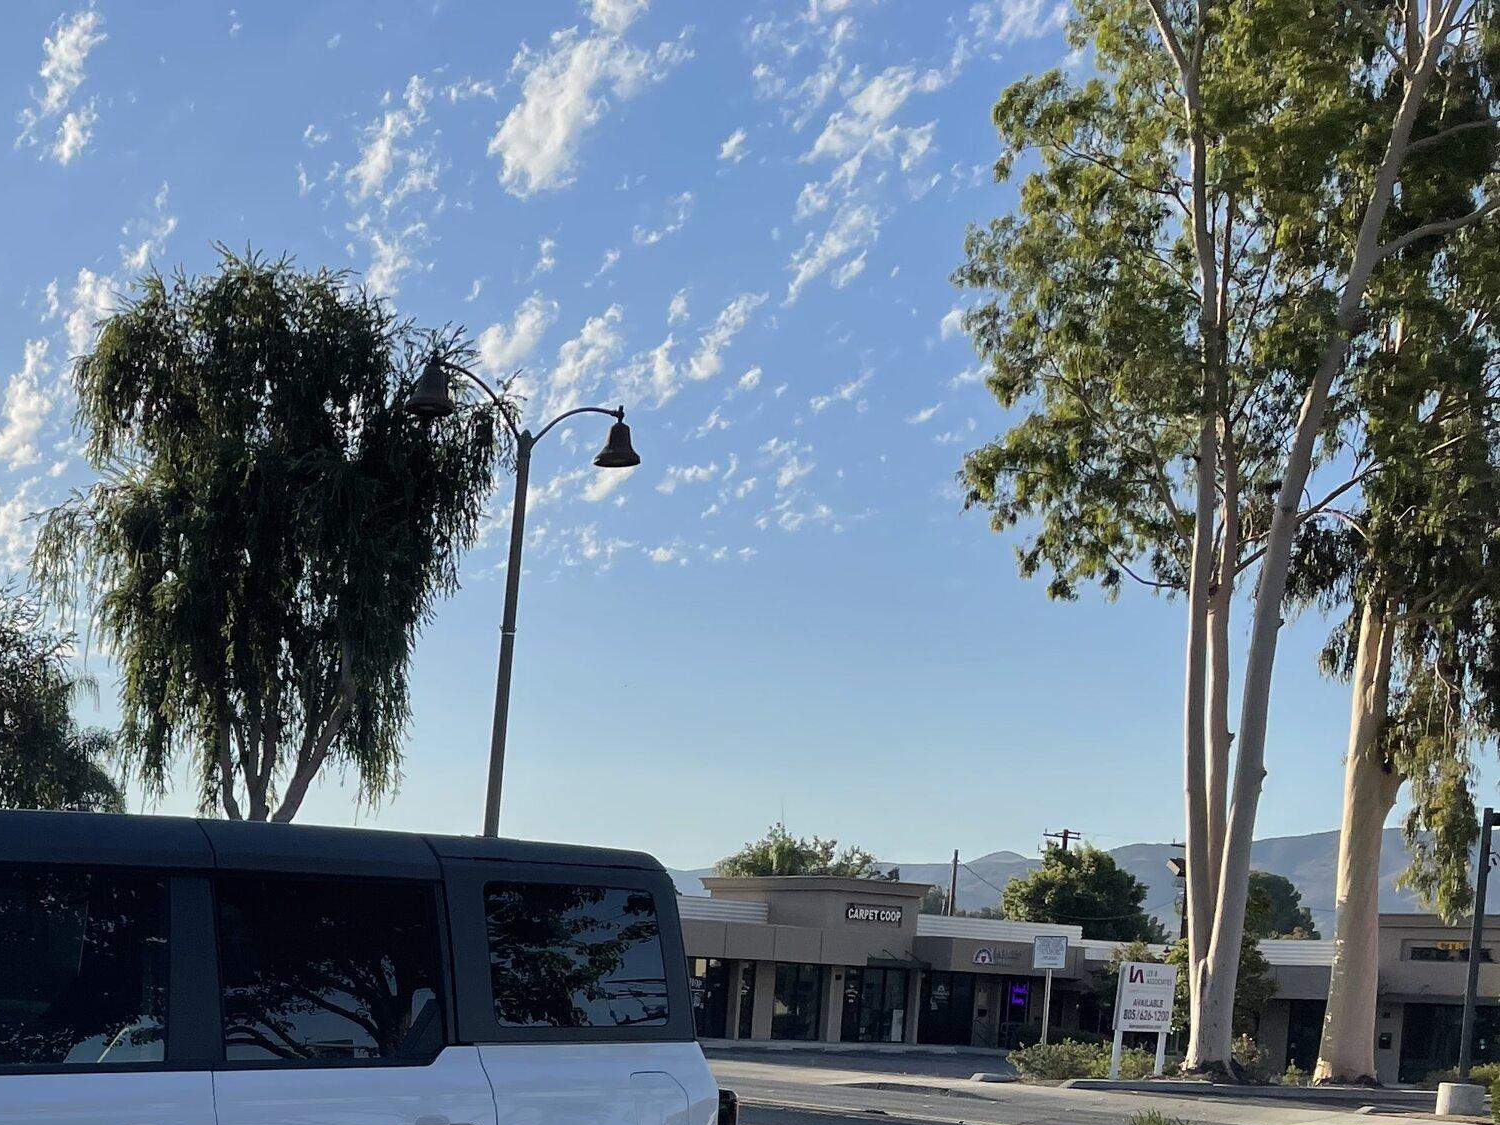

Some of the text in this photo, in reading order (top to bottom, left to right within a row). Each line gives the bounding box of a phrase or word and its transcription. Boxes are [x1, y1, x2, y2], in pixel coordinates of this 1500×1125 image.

[848, 908, 902, 922] CARPET COOP
[1132, 998, 1164, 1008] AVAILABLE
[1123, 1009, 1170, 1022] 805/626-1200
